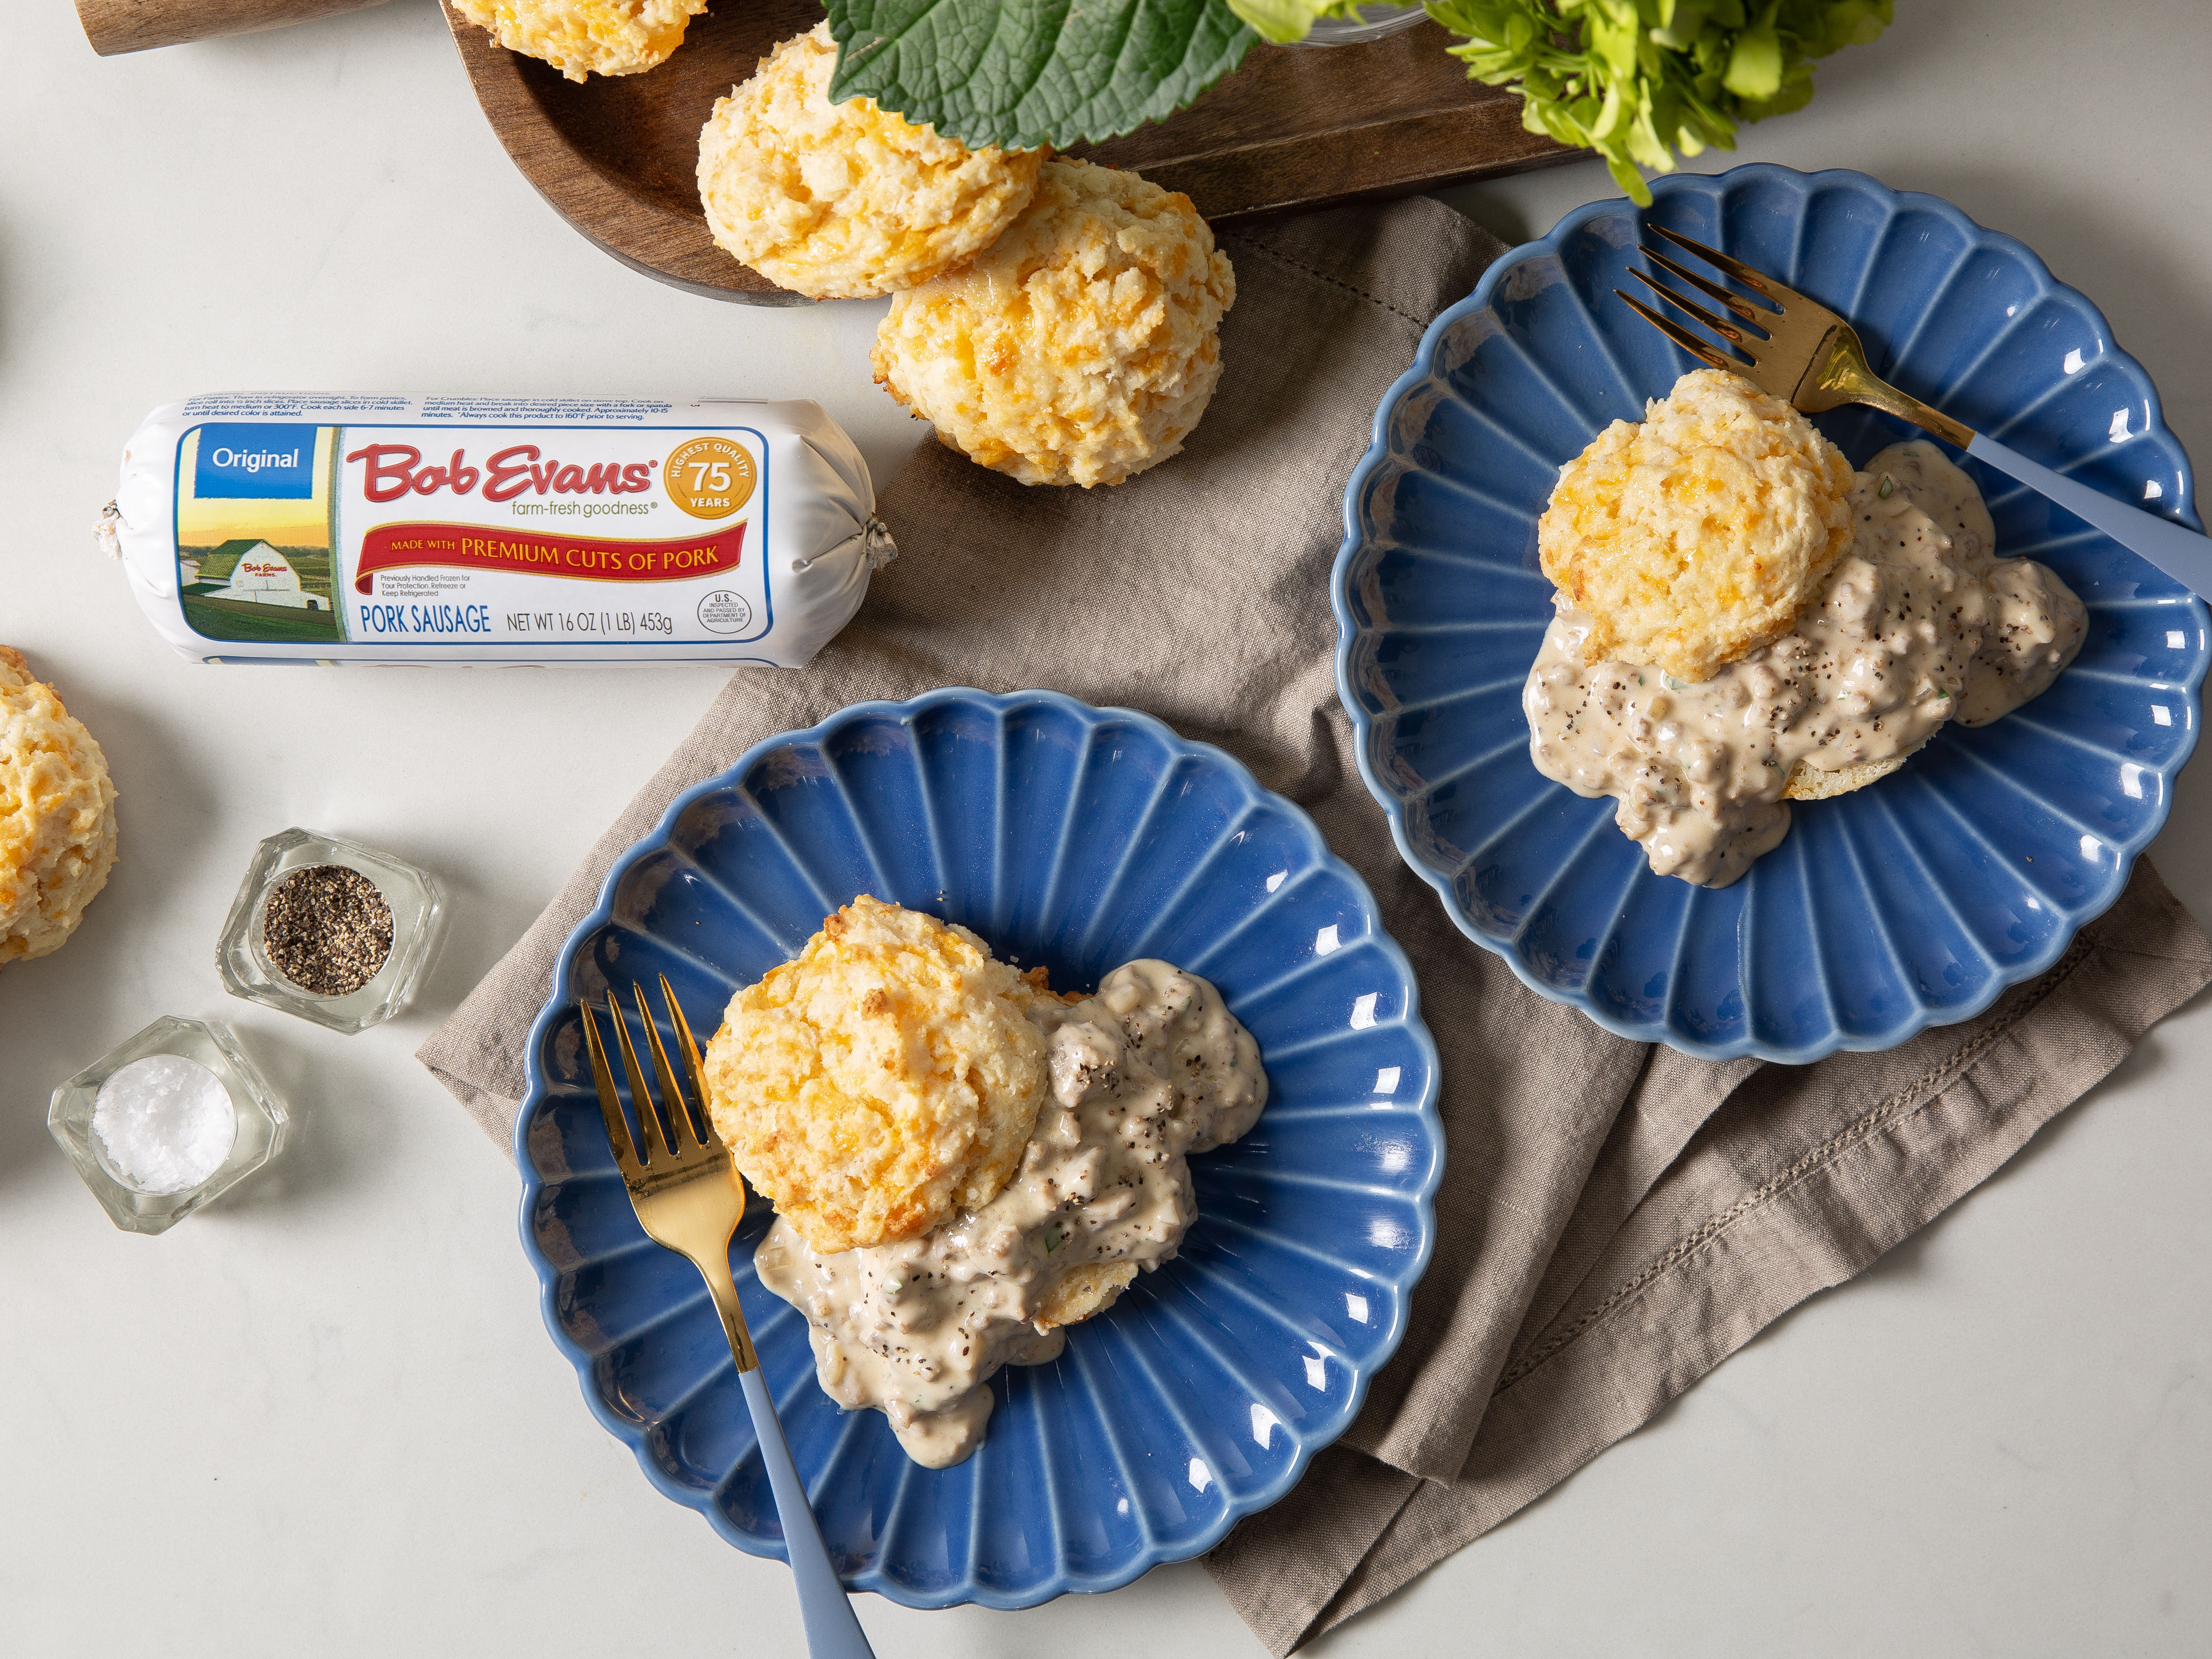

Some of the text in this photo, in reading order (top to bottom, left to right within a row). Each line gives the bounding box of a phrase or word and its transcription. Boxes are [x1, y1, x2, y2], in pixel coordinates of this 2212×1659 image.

[212, 448, 299, 473] Original
[671, 443, 749, 478] HIGHEST QUALITY
[346, 444, 480, 503] Bob
[688, 462, 732, 492] 75
[512, 501, 580, 515] farm-fresh
[690, 498, 731, 507] YEARS
[391, 538, 719, 570] MADE WITH PREMIUM CUTS OF PORK
[241, 563, 261, 572] Bob
[400, 590, 438, 598] Refrigerated
[714, 594, 732, 602] U.S.
[360, 604, 491, 633] PORK SAUSAGE
[506, 612, 672, 635] NET WT 16 OZ (1 LB) 453g
